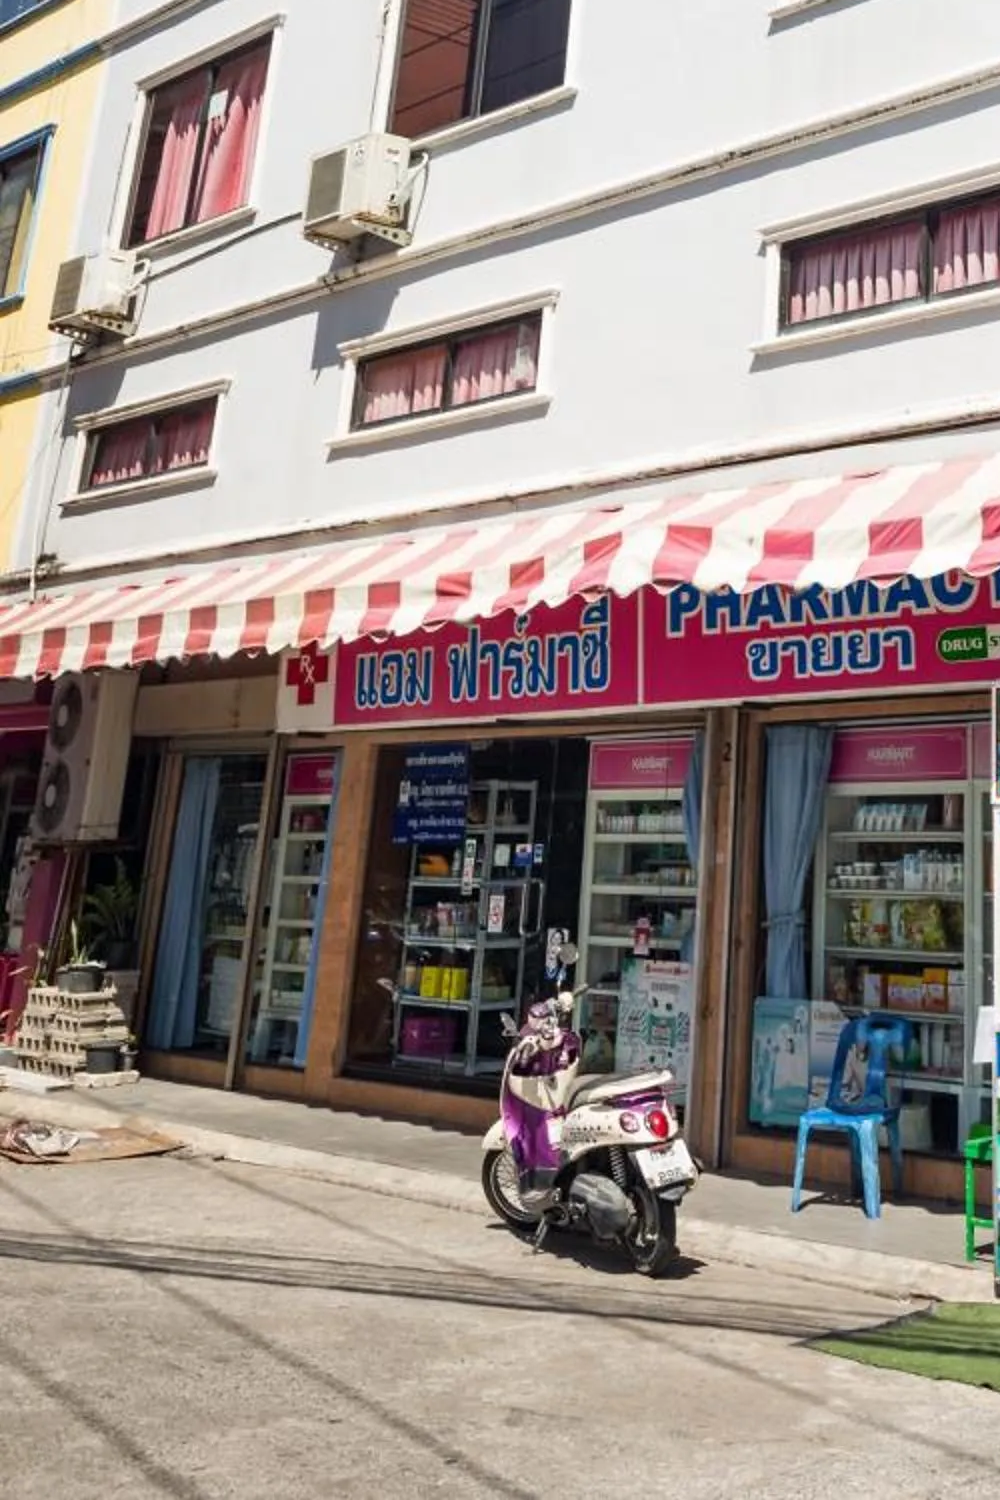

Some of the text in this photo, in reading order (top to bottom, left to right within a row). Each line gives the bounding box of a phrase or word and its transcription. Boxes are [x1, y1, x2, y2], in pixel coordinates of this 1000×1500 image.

[746, 624, 917, 681] ขายยา
[941, 638, 983, 653] DRUG
[356, 647, 433, 710] แอม
